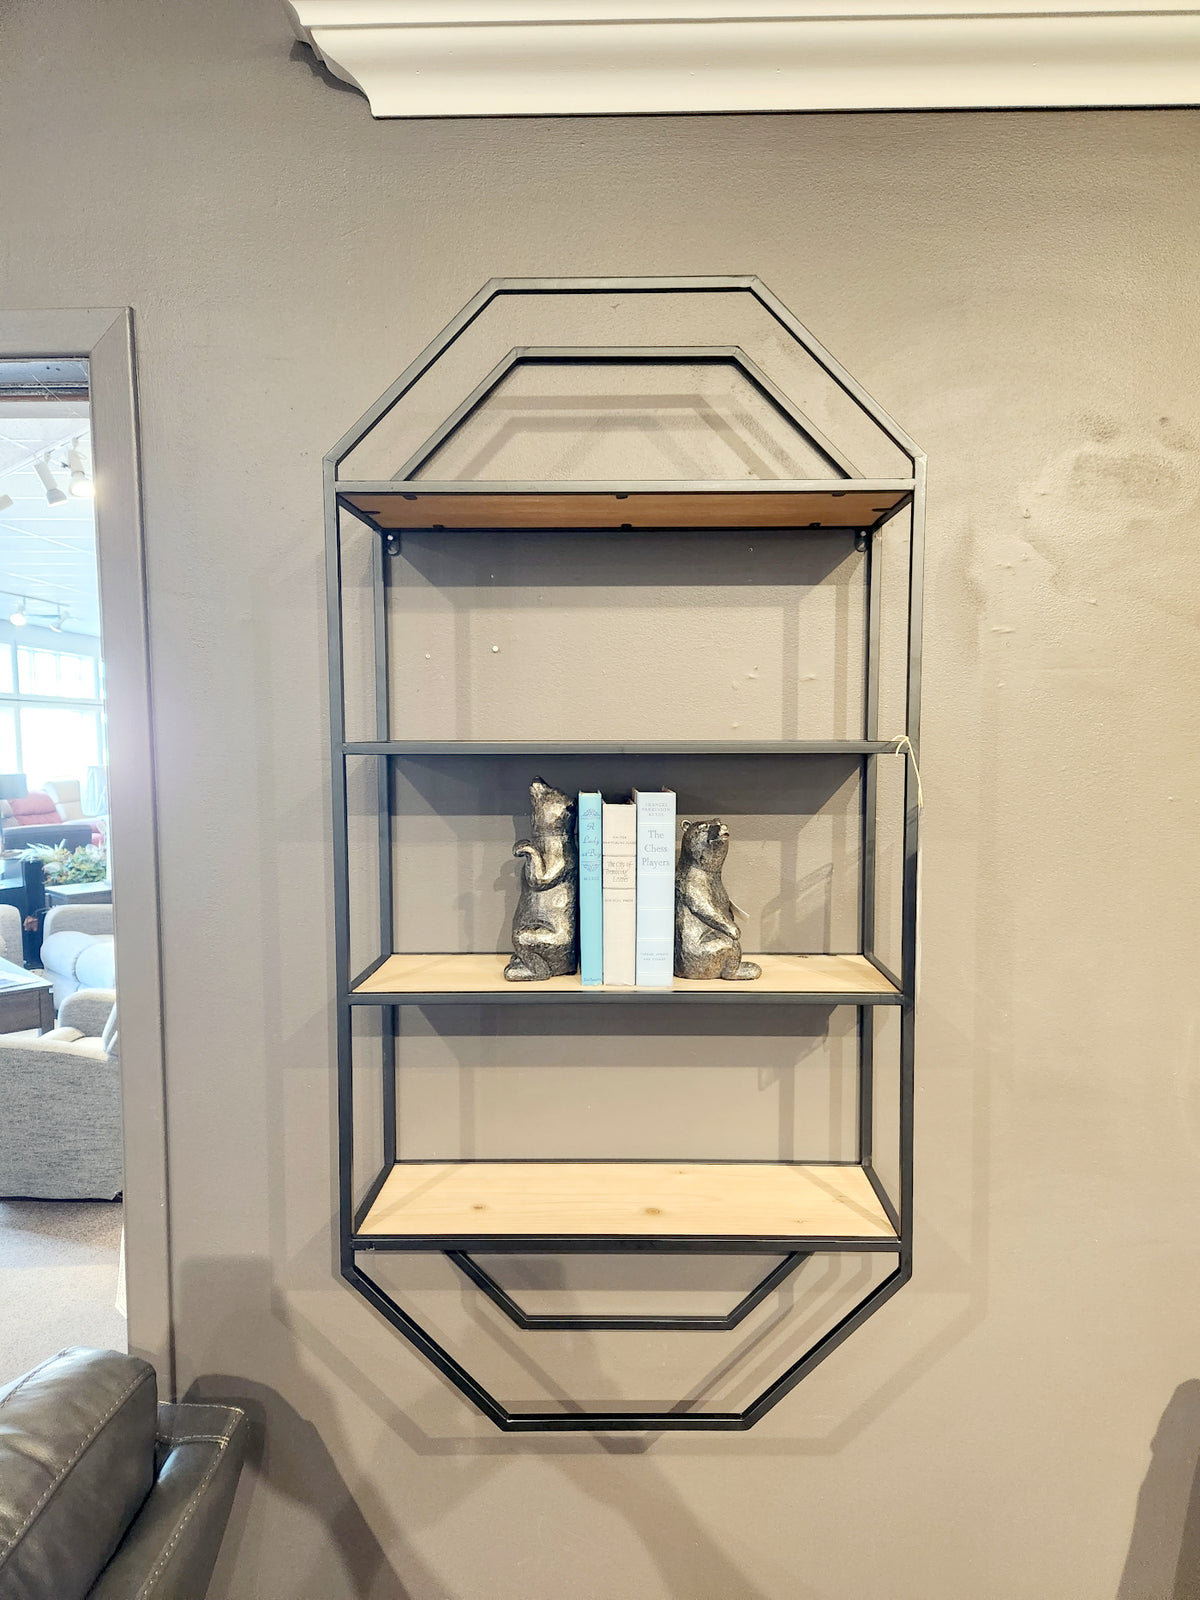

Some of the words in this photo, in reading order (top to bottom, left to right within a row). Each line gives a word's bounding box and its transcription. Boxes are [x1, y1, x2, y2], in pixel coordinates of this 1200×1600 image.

[647, 829, 665, 839] The
[644, 843, 668, 853] Chess
[642, 857, 670, 869] Players
